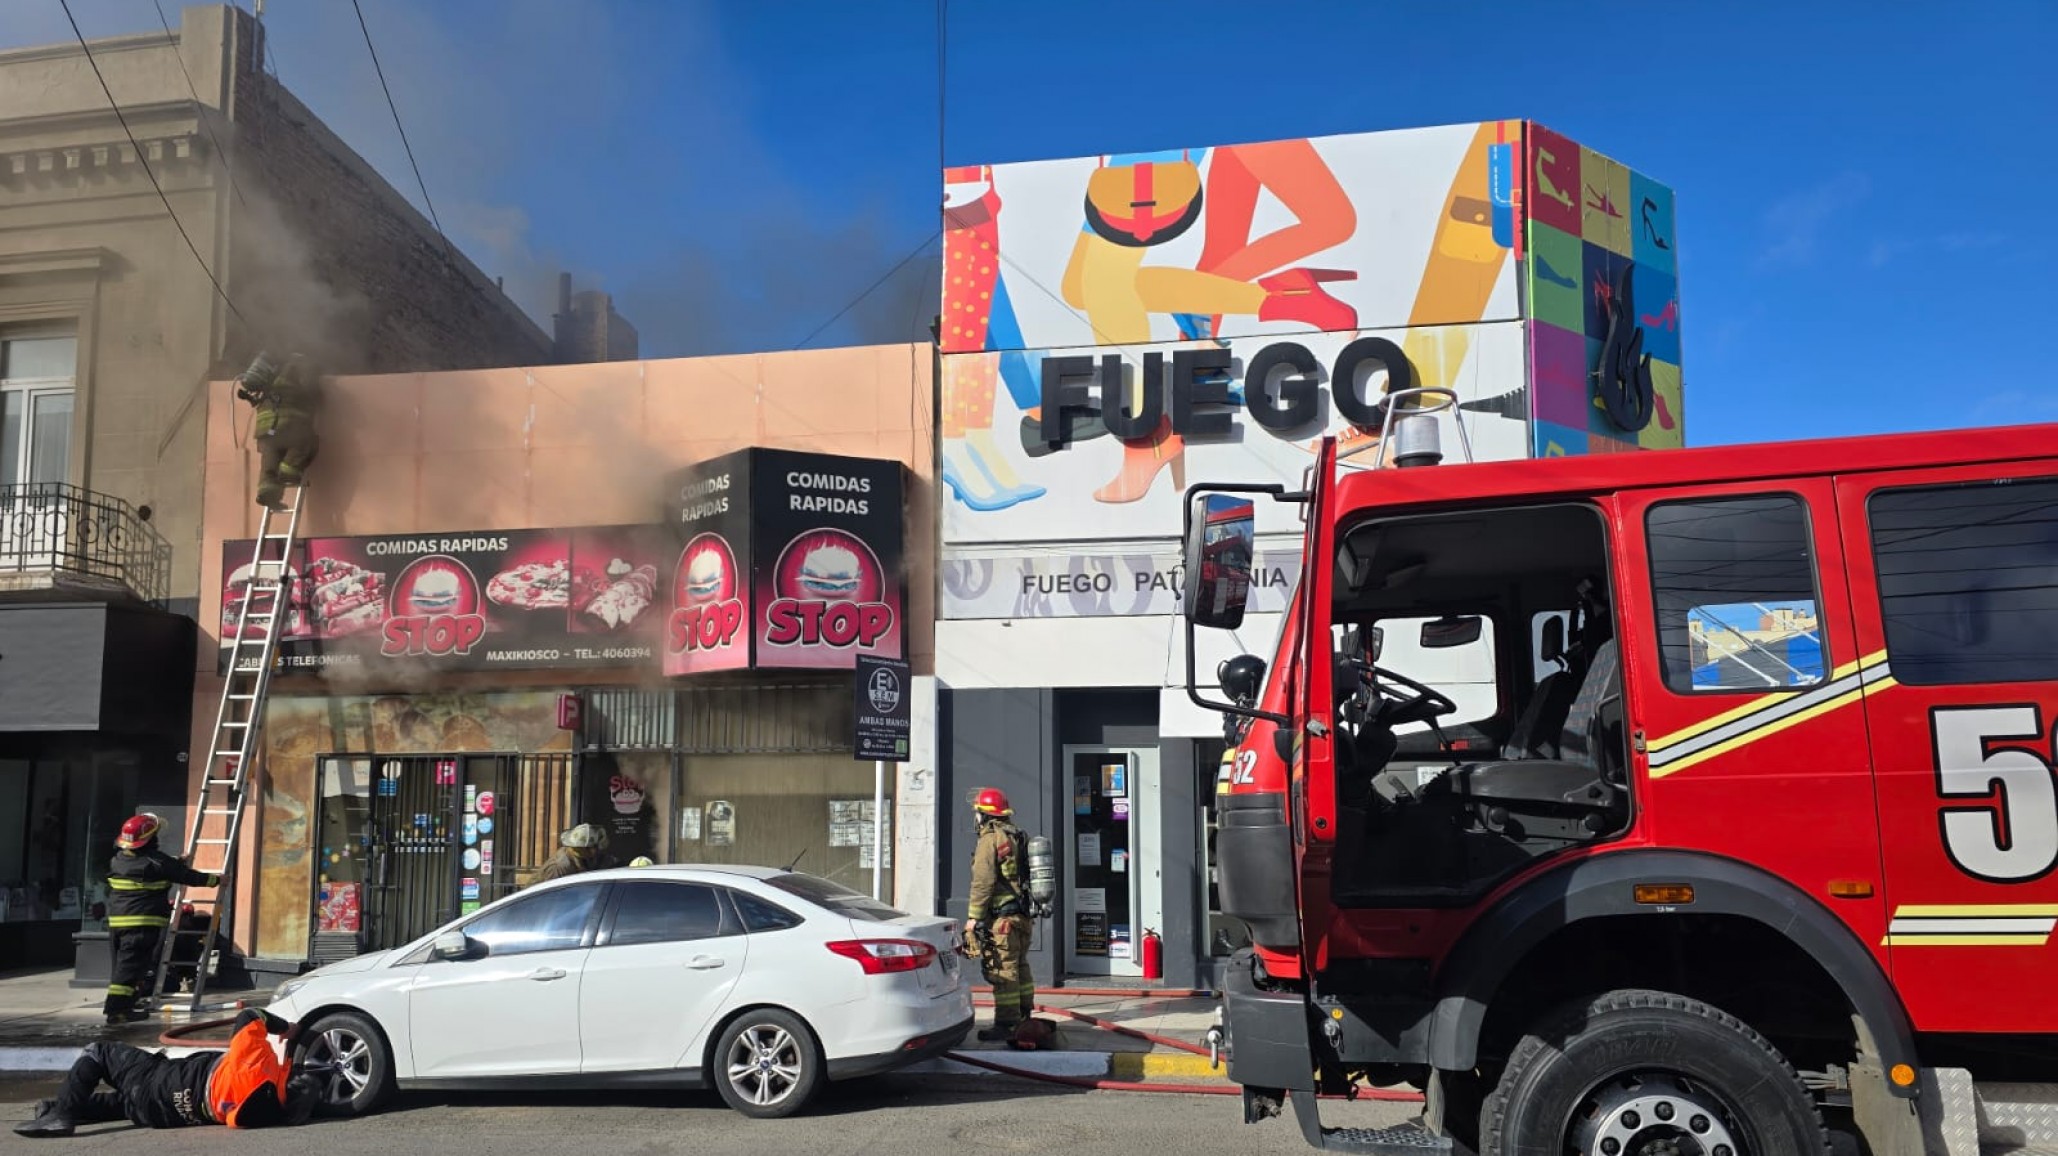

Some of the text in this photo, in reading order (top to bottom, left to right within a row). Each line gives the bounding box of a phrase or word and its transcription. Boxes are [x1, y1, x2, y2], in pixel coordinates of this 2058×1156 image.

[1040, 337, 1411, 440] FUEGO
[681, 474, 731, 501] COMIDAS
[787, 471, 871, 493] COMIDAS
[682, 497, 729, 523] RAPIDAS
[790, 494, 869, 515] RAPIDAS
[366, 537, 509, 556] COMIDAS RAPIDAS
[1022, 567, 1288, 594] FUEGO PATNIA
[382, 614, 486, 657] STOP
[669, 599, 742, 654] STOP
[766, 598, 894, 649] STOP
[485, 649, 560, 662] MAXIKIOSCO
[602, 646, 650, 660] 4060394
[1232, 749, 1258, 785] 52
